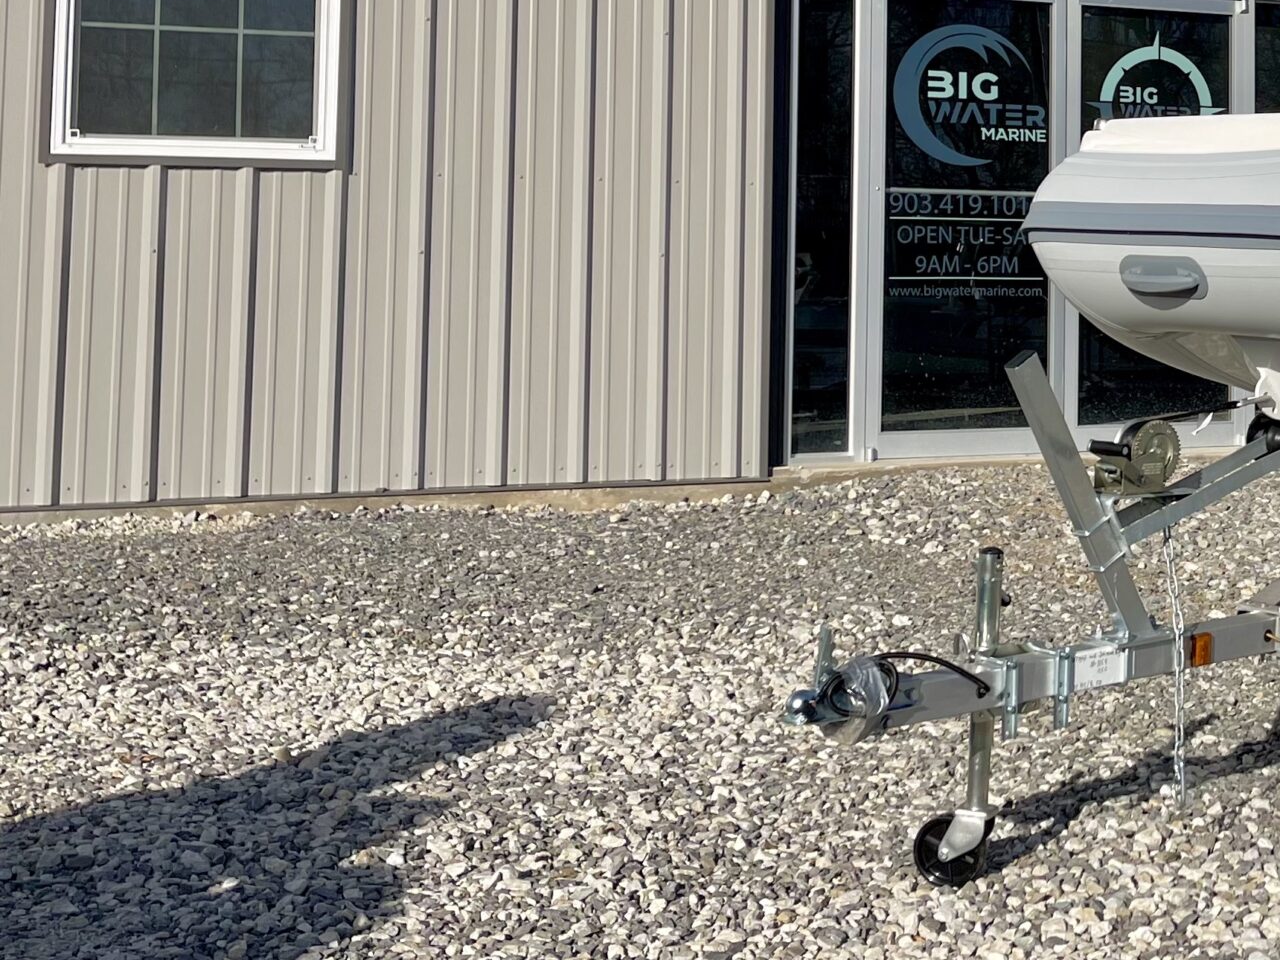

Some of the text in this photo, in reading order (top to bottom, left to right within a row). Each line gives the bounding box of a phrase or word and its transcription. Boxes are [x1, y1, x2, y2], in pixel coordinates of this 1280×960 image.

[927, 69, 999, 101] BIG
[1119, 85, 1159, 105] BIG
[928, 100, 1046, 127] WATER
[980, 127, 1047, 143] MARINE
[889, 192, 1030, 216] 903.419.101
[896, 225, 1028, 246] OPEN TUE-SA
[914, 255, 961, 274] 9AM
[976, 255, 1020, 275] 6PM
[888, 284, 1044, 300] www.bigwatermarine.com
